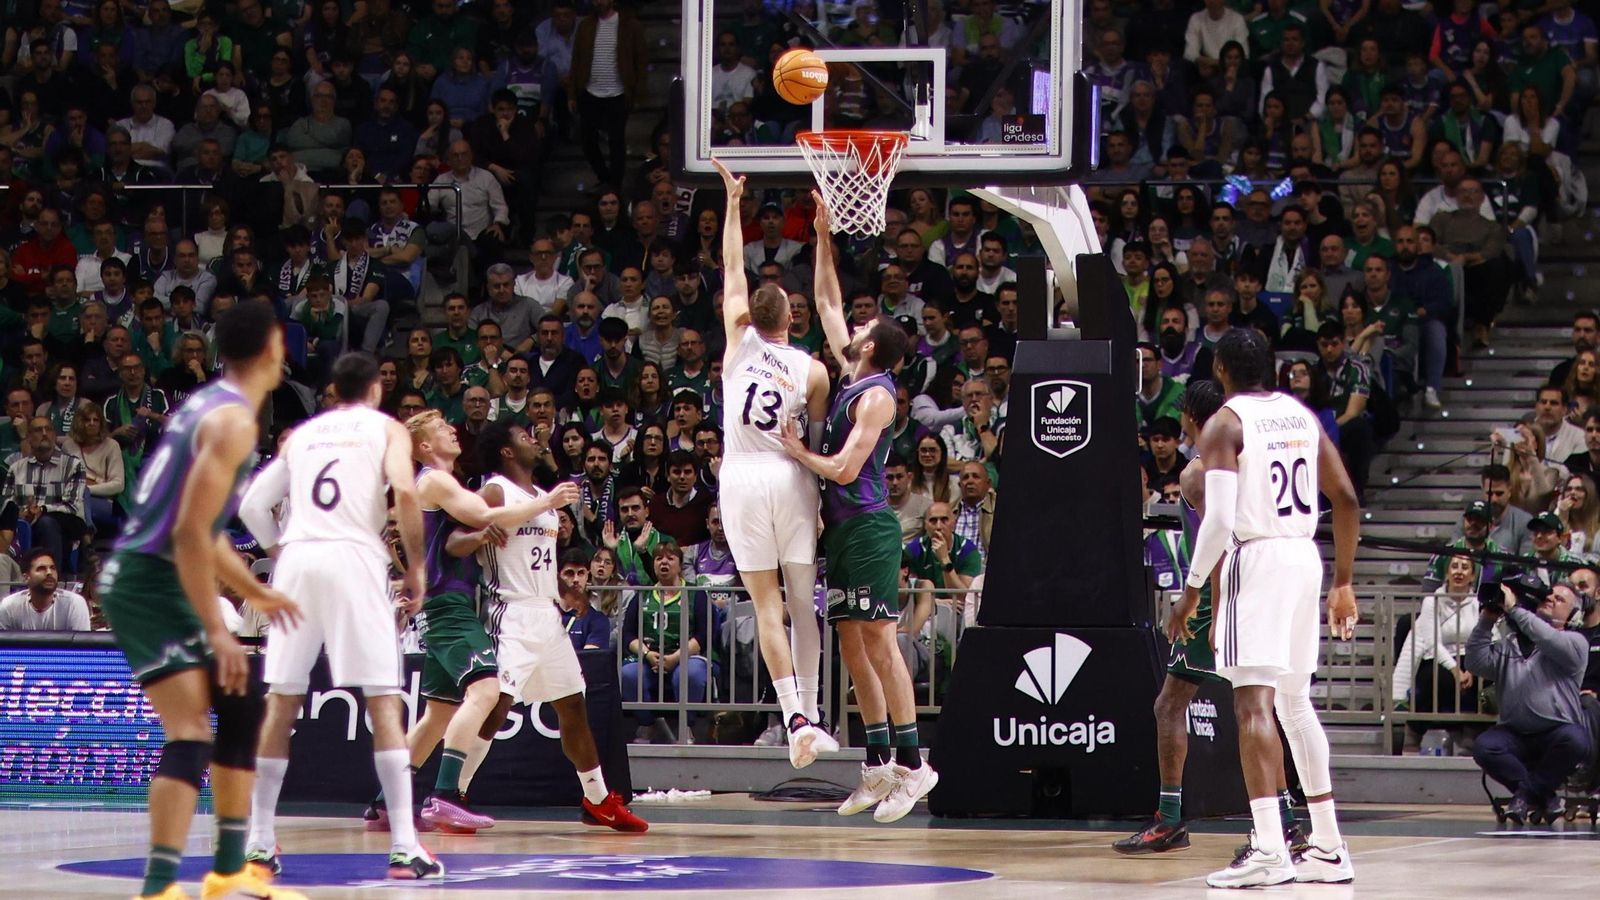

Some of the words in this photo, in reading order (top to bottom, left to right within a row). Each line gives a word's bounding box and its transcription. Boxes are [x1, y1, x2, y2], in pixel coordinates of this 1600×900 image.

[1003, 123, 1022, 134] liga
[1003, 132, 1044, 142] endesa
[762, 351, 790, 376] MUSA
[742, 382, 783, 431] 13
[1040, 416, 1082, 425] Fundación
[1254, 416, 1308, 433] FERNANDO
[1040, 434, 1082, 442] Baloncesto
[1046, 426, 1077, 436] Unicaja
[1267, 440, 1310, 450] AUTOHERO
[311, 458, 341, 512] 6
[1270, 457, 1311, 517] 20
[530, 546, 553, 571] 24
[993, 714, 1116, 753] Unicaja
